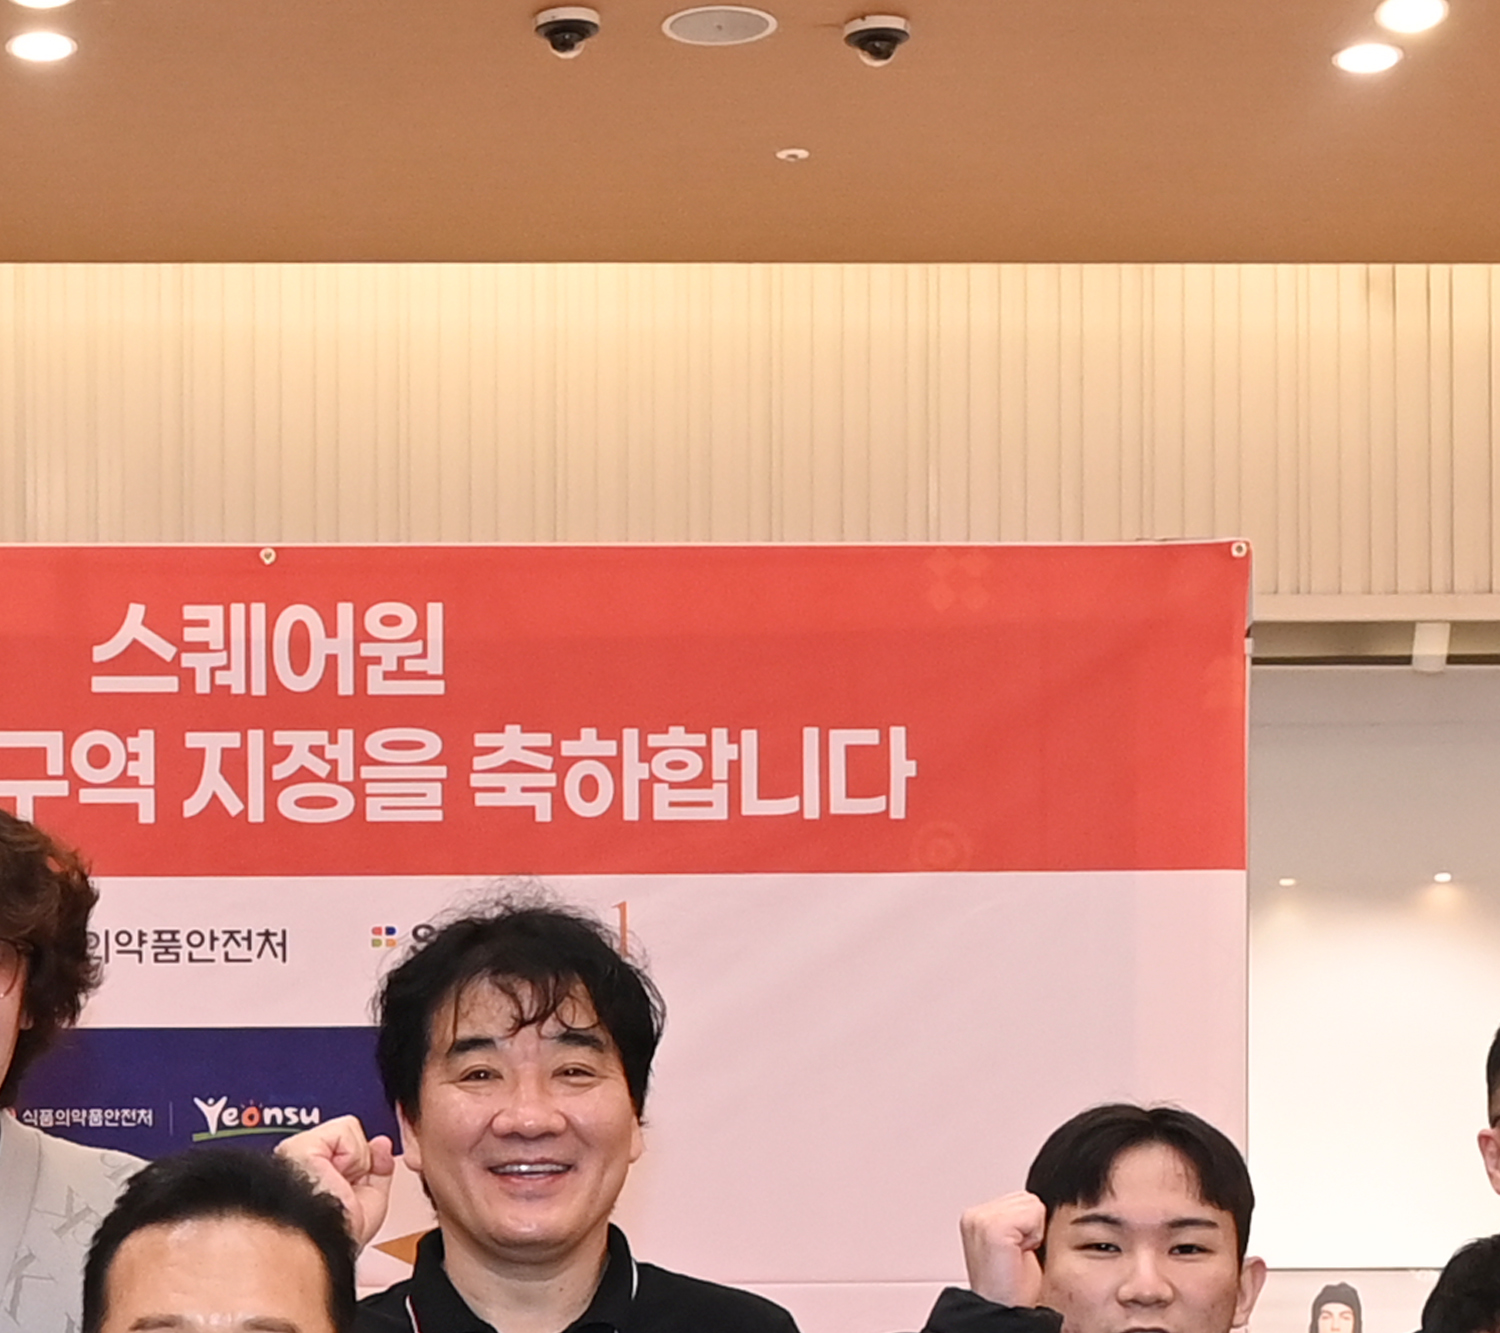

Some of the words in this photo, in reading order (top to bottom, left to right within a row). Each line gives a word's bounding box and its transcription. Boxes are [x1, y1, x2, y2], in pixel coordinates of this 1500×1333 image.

[90, 601, 446, 696] 스퀘어원
[182, 727, 448, 823] 지정을
[469, 724, 917, 822] 축하합니다
[85, 928, 288, 965] 의약품안전처
[21, 1107, 154, 1128] 식품의약품안전처
[193, 1095, 321, 1136] Yeonsu
